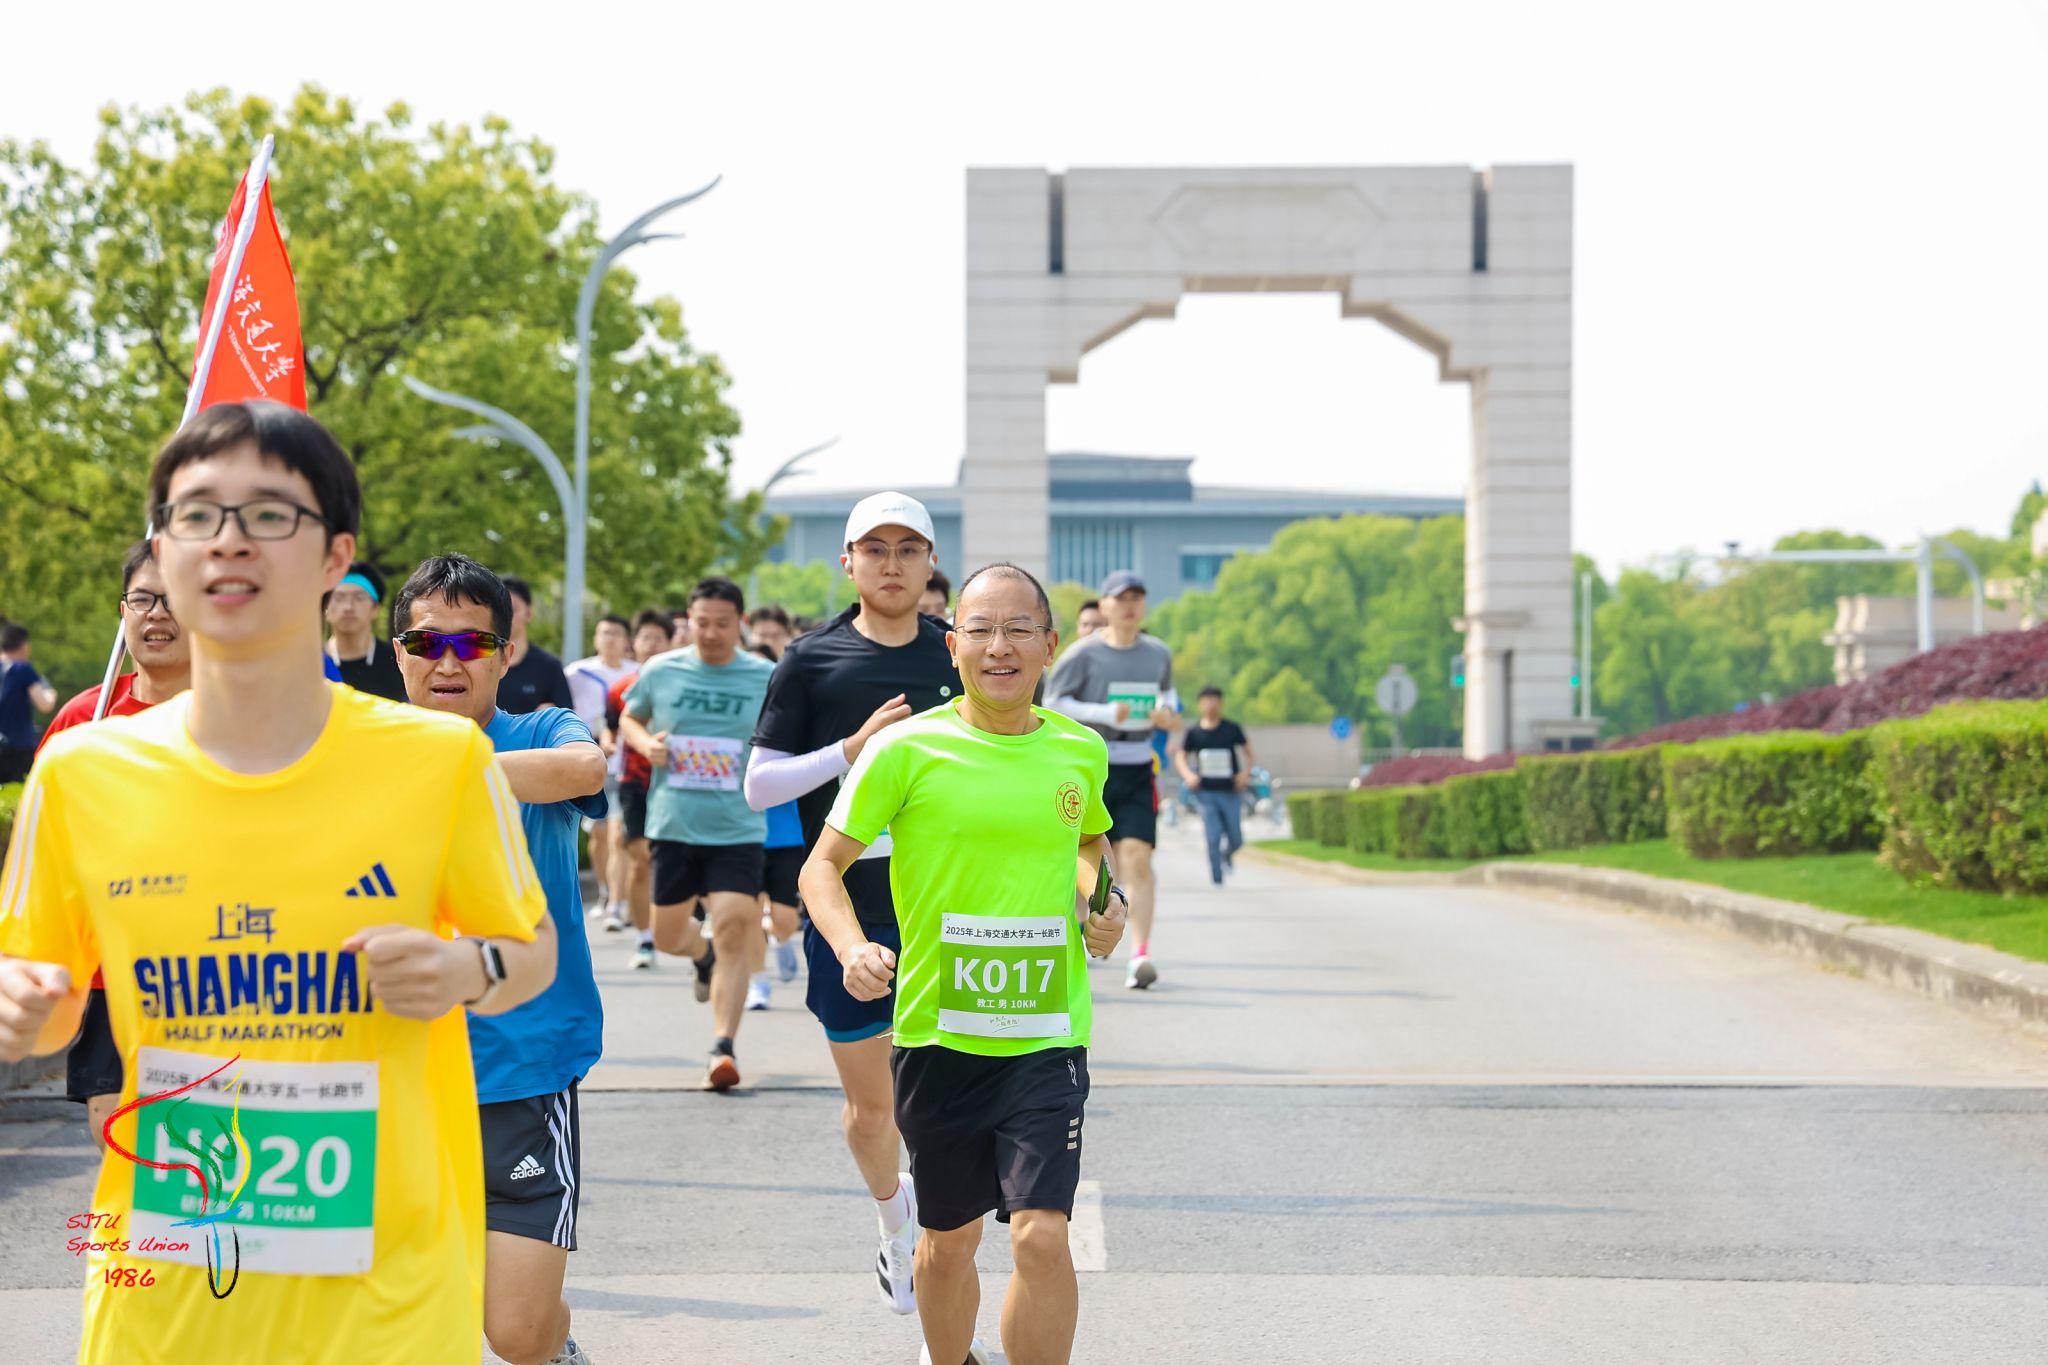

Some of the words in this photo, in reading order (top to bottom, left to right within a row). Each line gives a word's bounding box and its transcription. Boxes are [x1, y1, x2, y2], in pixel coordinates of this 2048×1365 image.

[208, 903, 276, 944] 上海
[945, 925, 1061, 939] 2025年上海交通大学五一长跑节
[134, 951, 373, 1018] SHANGHA
[954, 957, 1055, 993] K017
[977, 998, 995, 1008] 教工
[998, 999, 1007, 1009] 男
[1011, 999, 1037, 1009] 10KM
[165, 1025, 216, 1041] HALF
[221, 1022, 344, 1041] MARATHON
[152, 1122, 352, 1198] H020
[510, 1166, 546, 1180] adidas
[262, 1203, 316, 1222] 10KM
